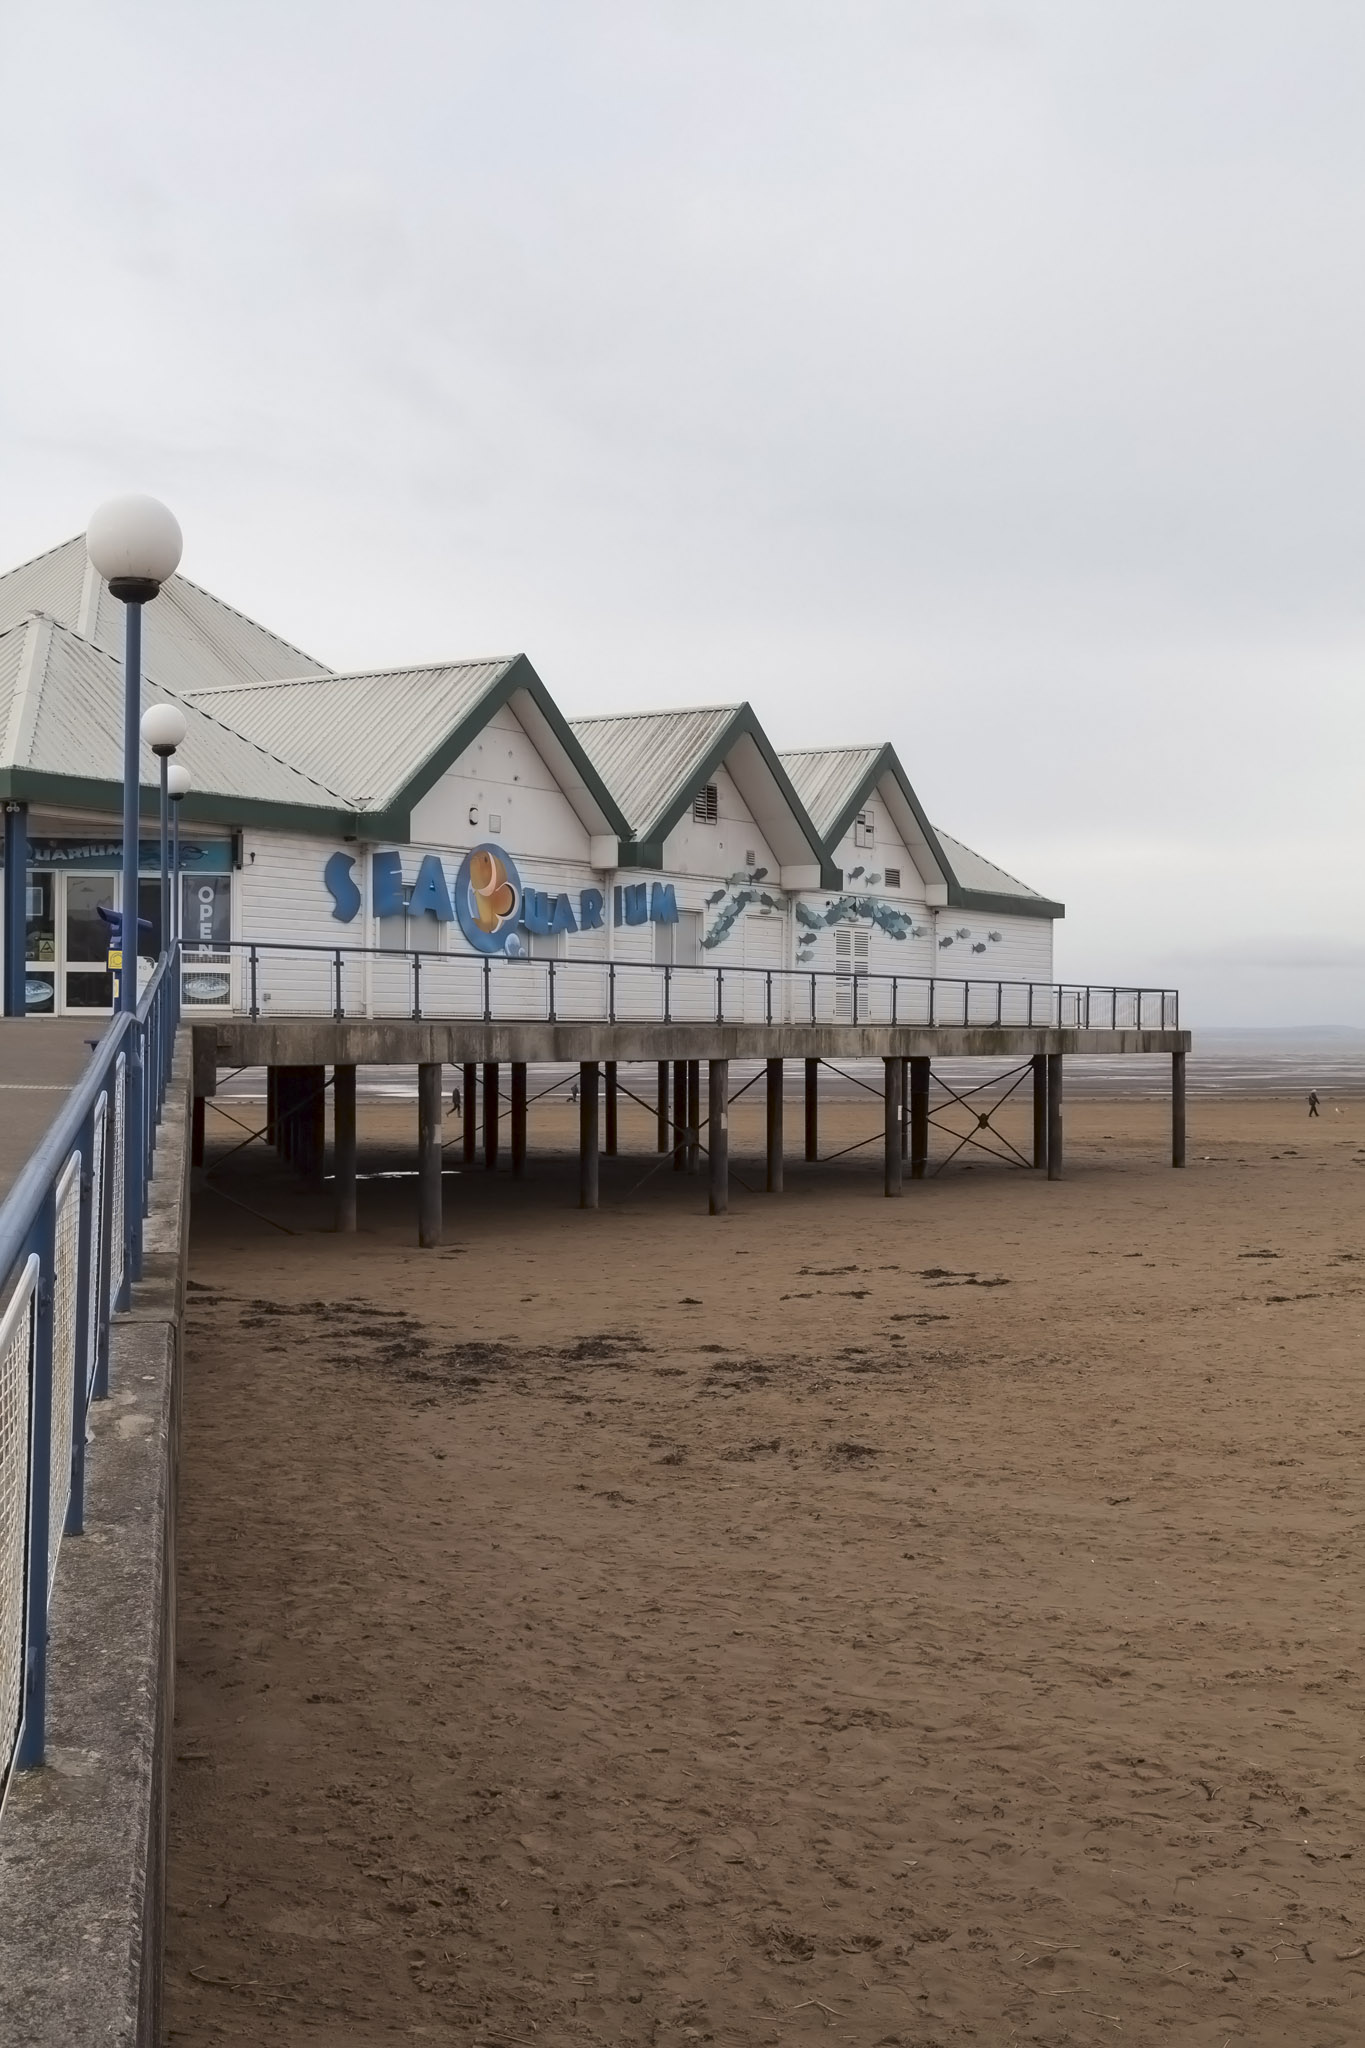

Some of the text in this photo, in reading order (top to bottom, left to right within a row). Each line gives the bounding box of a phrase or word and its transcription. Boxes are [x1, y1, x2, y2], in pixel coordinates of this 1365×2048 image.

[27, 844, 123, 861] UARIUM
[198, 886, 214, 957] OPEN
[324, 842, 679, 956] SEAQUARIUM
